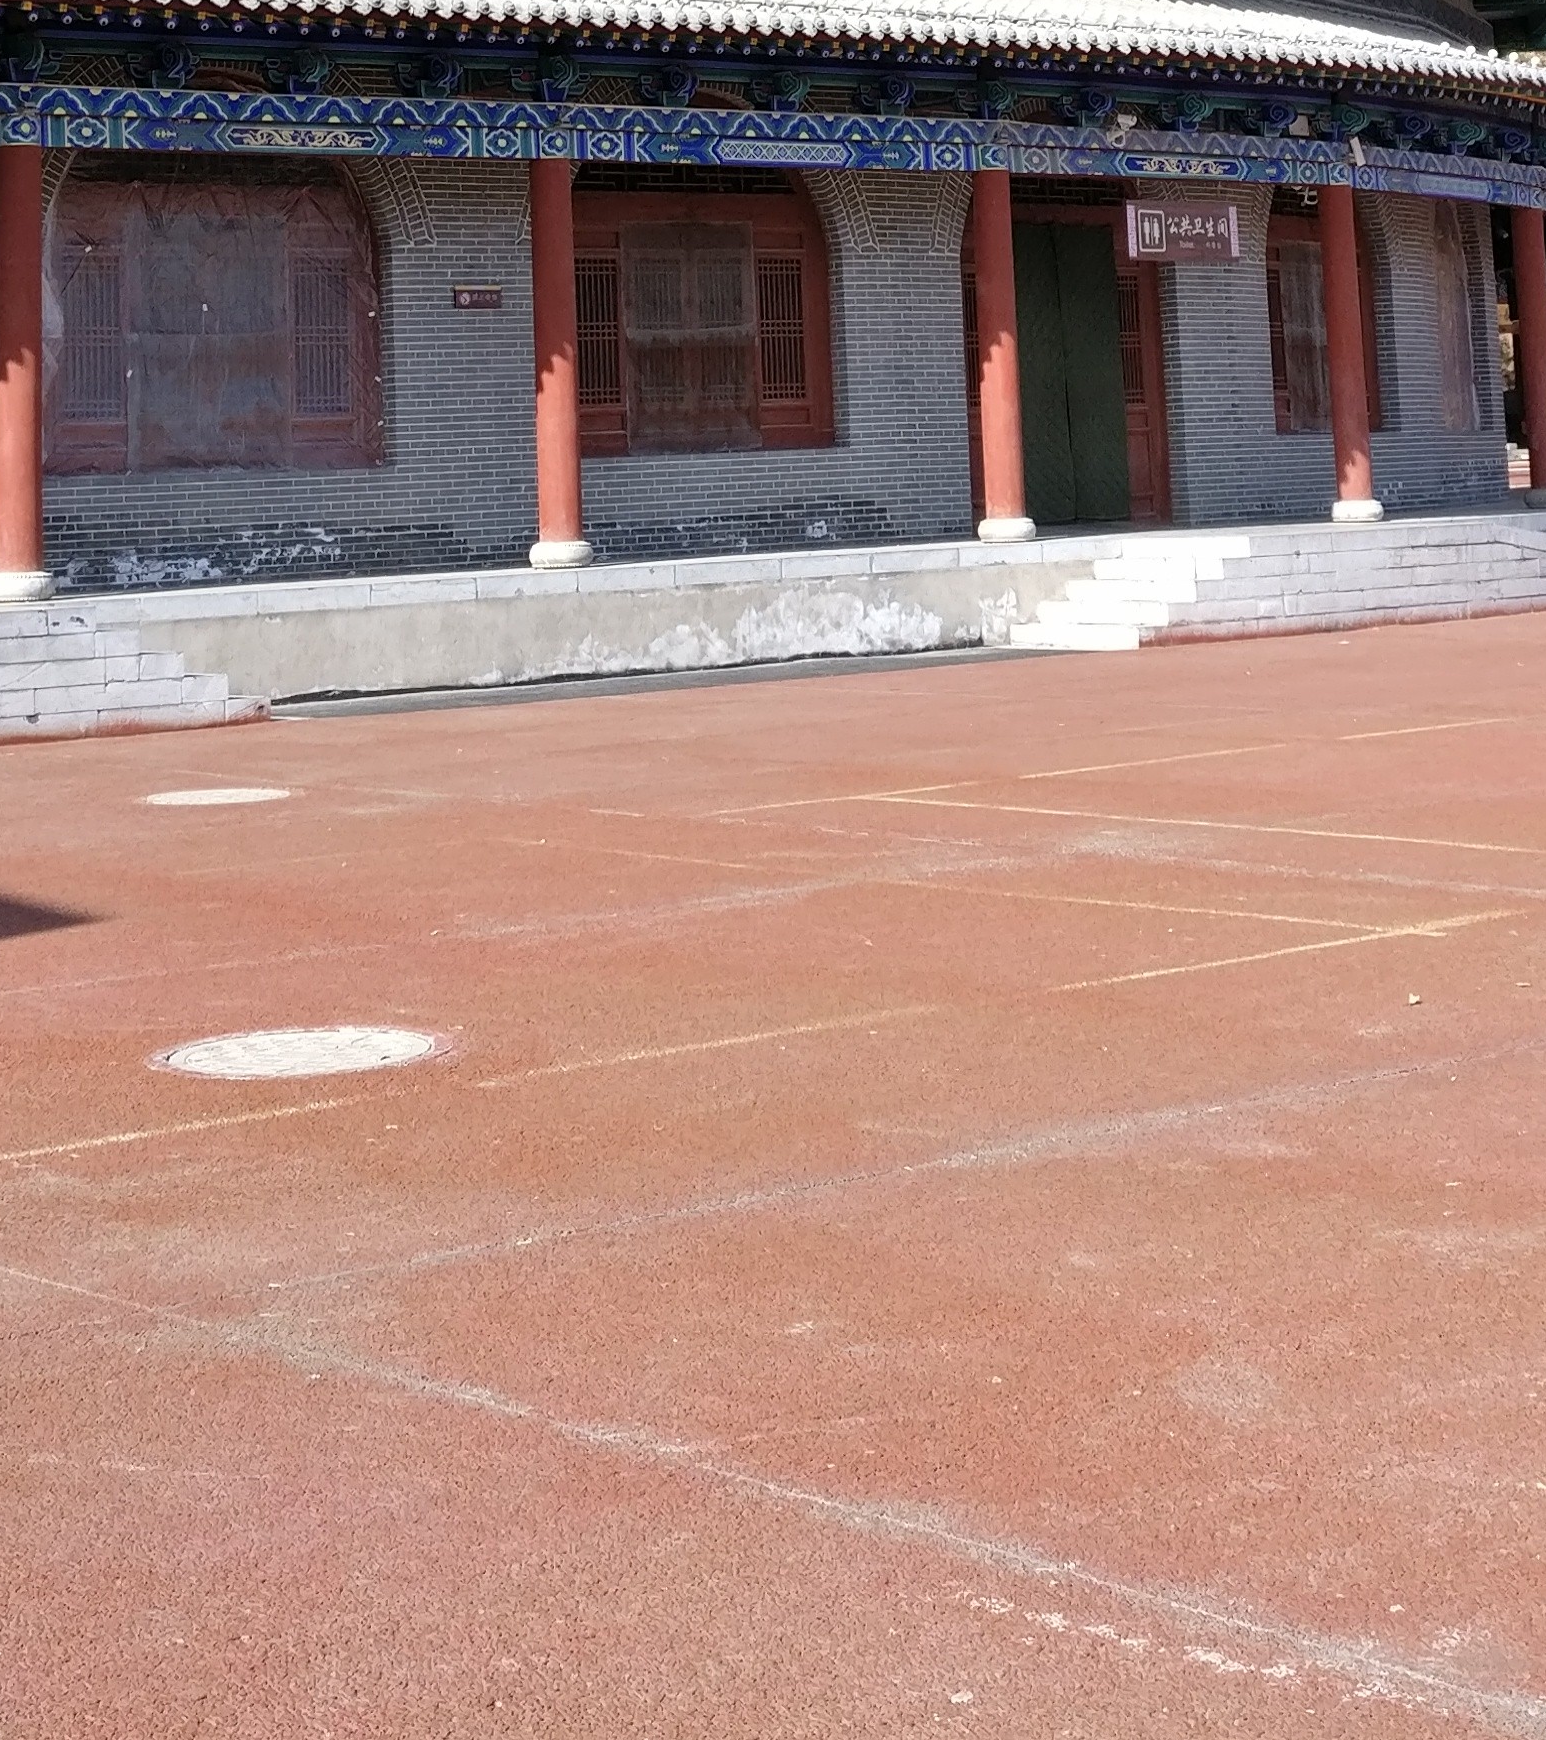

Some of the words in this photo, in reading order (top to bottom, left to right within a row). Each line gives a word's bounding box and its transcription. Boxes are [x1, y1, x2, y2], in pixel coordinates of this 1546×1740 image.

[1166, 213, 1228, 238] 公共卫生间
